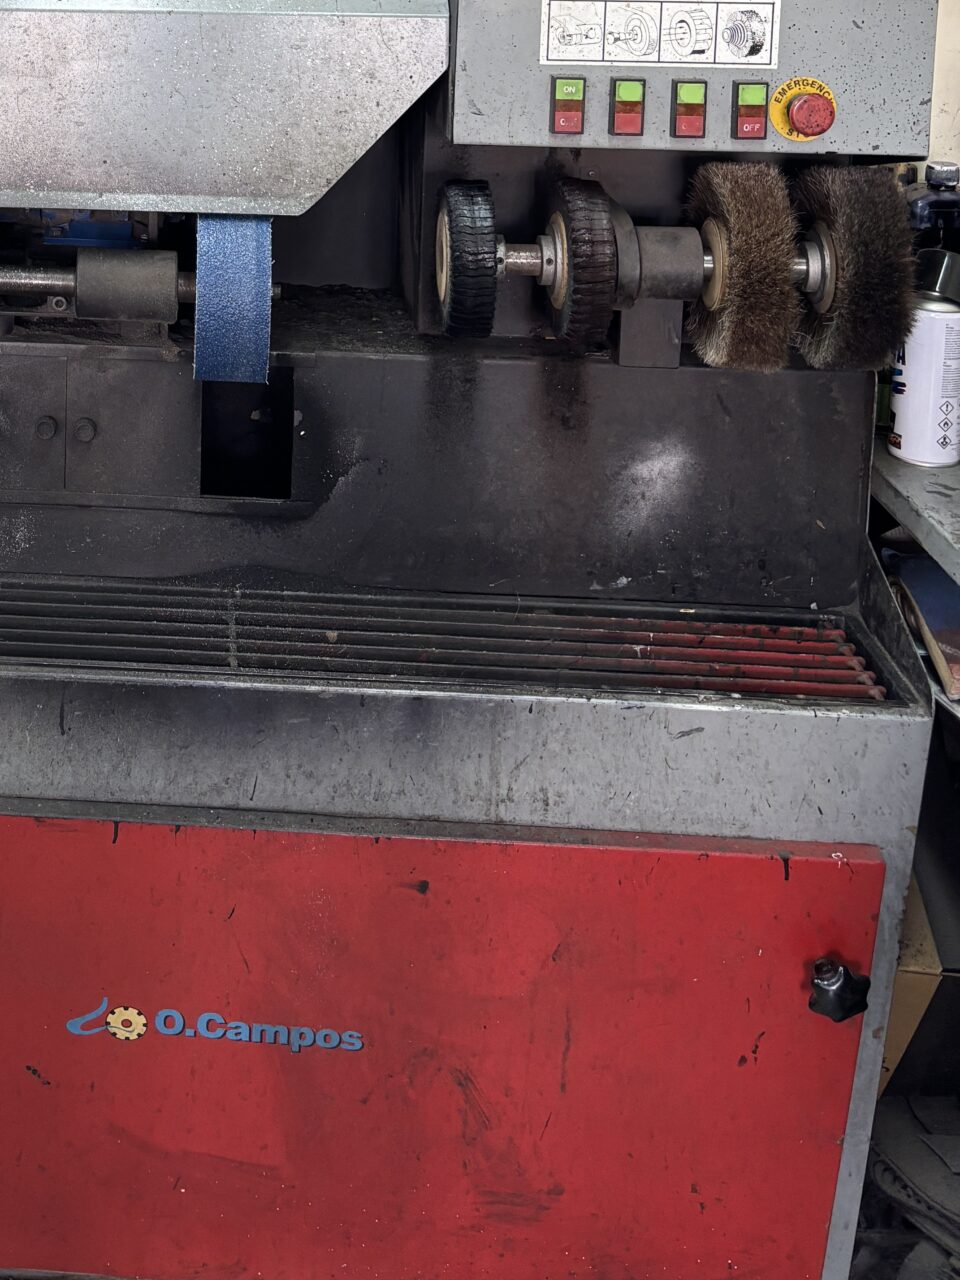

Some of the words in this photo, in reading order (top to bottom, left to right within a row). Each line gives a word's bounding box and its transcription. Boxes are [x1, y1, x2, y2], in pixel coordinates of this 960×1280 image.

[563, 85, 576, 94] ON
[743, 123, 761, 132] OFF
[154, 1008, 365, 1054] O.Campos
